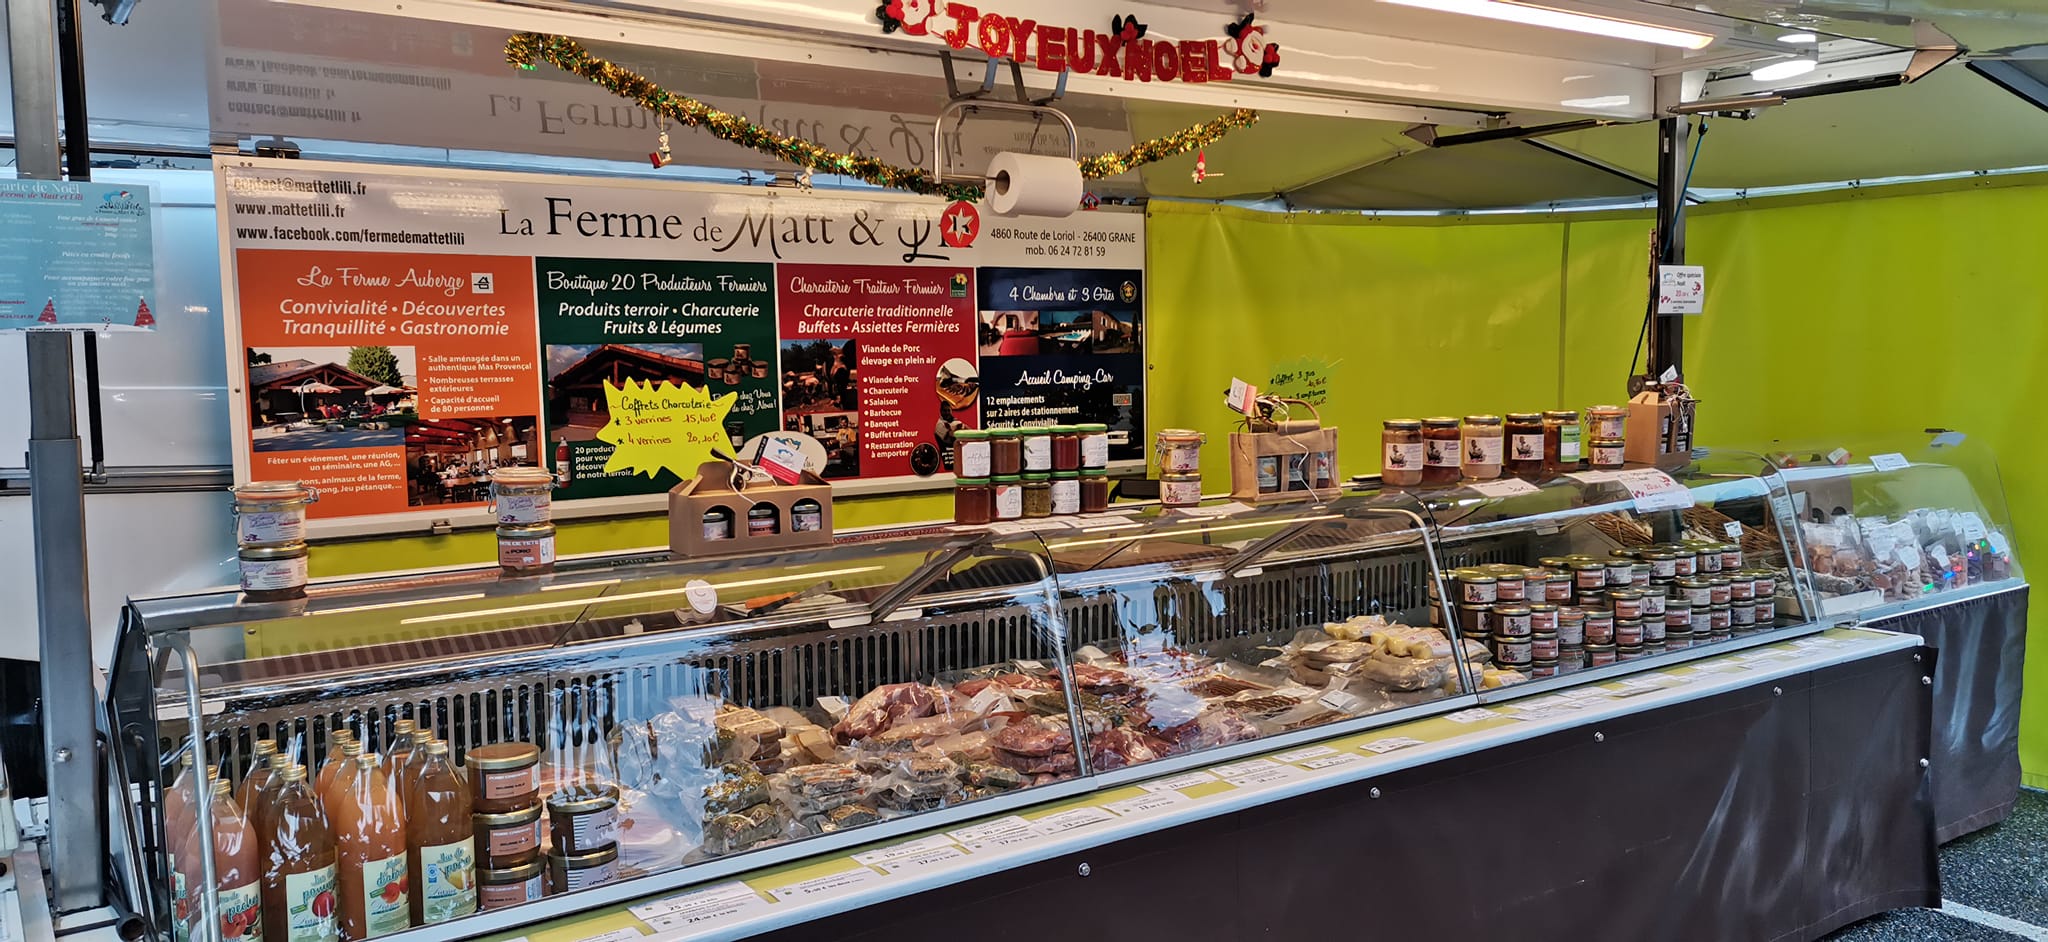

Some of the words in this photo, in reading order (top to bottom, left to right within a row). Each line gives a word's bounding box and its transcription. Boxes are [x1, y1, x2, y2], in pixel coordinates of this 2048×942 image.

[944, 2, 1121, 77] JOYEUX
[1123, 39, 1232, 84] NOEL
[233, 177, 367, 196] contact@mattetlili.fr
[235, 202, 345, 218] www.mattetlili.fr
[499, 209, 535, 236] La
[544, 197, 683, 240] Ferme
[693, 217, 723, 242] de
[712, 205, 834, 259] Matt
[849, 209, 884, 246] &
[237, 226, 465, 246] www.facebook.com/fermedemattetlili
[991, 228, 1011, 240] 4860
[1014, 229, 1038, 240] Route
[1040, 229, 1050, 240] de
[1053, 230, 1075, 241] Loriol
[1083, 231, 1106, 242] 26400
[1108, 232, 1135, 243] GRANE
[1025, 245, 1046, 255] mob.
[1048, 245, 1058, 255] 06
[1060, 245, 1070, 256] 24
[1073, 246, 1082, 256] 72
[1084, 246, 1093, 256] 81
[1096, 246, 1106, 256] 59
[296, 266, 332, 287] La
[336, 267, 391, 287] Ferme
[394, 268, 465, 297] Auberge
[547, 271, 608, 297] Boutique
[611, 274, 635, 292] 20
[641, 273, 712, 293] Producteurs
[716, 275, 767, 293] Fermiers
[790, 277, 851, 295] Charcuterie
[853, 278, 900, 295] Traiteur
[902, 279, 944, 295] Fermier
[1009, 289, 1019, 301] 4
[1022, 288, 1065, 302] Chambres
[1067, 289, 1078, 301] et
[1081, 288, 1089, 301] 3
[280, 298, 388, 316] Convivialité
[402, 300, 506, 317] Découvertes
[558, 303, 621, 316] Produits
[624, 303, 669, 317] terroir
[681, 303, 759, 317] Charcuterie
[803, 304, 874, 318] Charcuterie
[876, 304, 953, 318] traditionnelle
[282, 319, 387, 338] Tranquillité
[400, 320, 509, 336] Gastronomie
[604, 320, 644, 334] Fruits
[647, 321, 658, 334] &
[661, 321, 722, 337] Légumes
[798, 320, 841, 333] Buffets
[851, 320, 903, 333] Assiettes
[906, 319, 960, 333] Fermières
[861, 344, 889, 353] Viande
[890, 344, 900, 354] de
[902, 344, 920, 353] Porc
[428, 354, 446, 363] Salle
[448, 354, 488, 365] aménagée
[489, 354, 508, 363] dans
[861, 356, 892, 366] élevage
[893, 357, 903, 365] en
[905, 355, 923, 366] plein
[925, 355, 936, 364] air
[428, 363, 476, 373] authentique
[495, 363, 532, 372] Provençal
[429, 375, 473, 384] Nombreuses
[474, 375, 515, 383] terrasses
[868, 375, 891, 384] Viande
[892, 375, 901, 384] de
[903, 375, 919, 384] Porc
[1014, 369, 1051, 386] Accueil
[1053, 368, 1114, 390] Camping-Car
[429, 384, 474, 393] extérieures
[869, 386, 908, 395] Charcuterie
[431, 395, 464, 405] Capacité
[465, 395, 500, 404] d'accueil
[869, 397, 898, 407] Salaison
[987, 397, 995, 405] 12
[996, 395, 1045, 407] emplacements
[431, 405, 441, 413] de
[442, 405, 452, 413] 80
[454, 405, 494, 414] personnes
[621, 396, 660, 418] Coffrets
[661, 397, 712, 409] Charcuterie
[869, 408, 902, 418] Barbecue
[987, 409, 997, 417] sur
[999, 408, 1003, 416] 2
[1005, 407, 1020, 416] aires
[1021, 407, 1030, 416] de
[1032, 405, 1079, 416] stationnement
[625, 413, 633, 426] 3
[634, 416, 672, 425] verrines
[869, 419, 899, 429] Banquet
[986, 420, 1015, 429] Sécurité
[1020, 417, 1058, 427] Convivialité
[627, 432, 634, 445] 4
[636, 436, 672, 445] verrines
[870, 430, 891, 440] Buffet
[892, 429, 918, 438] traiteur
[870, 440, 915, 450] Restauration
[267, 456, 289, 465] Fêter
[302, 454, 349, 464] événement,
[368, 452, 400, 461] réunion,
[575, 456, 593, 464] pour
[871, 450, 876, 458] à
[877, 449, 909, 460] emporter
[322, 461, 362, 471] séminaire,
[379, 460, 393, 468] AG,
[321, 474, 355, 484] animaux
[357, 473, 367, 482] de
[368, 473, 376, 481] la
[377, 472, 401, 482] ferme,
[355, 483, 394, 493] pétanque,
